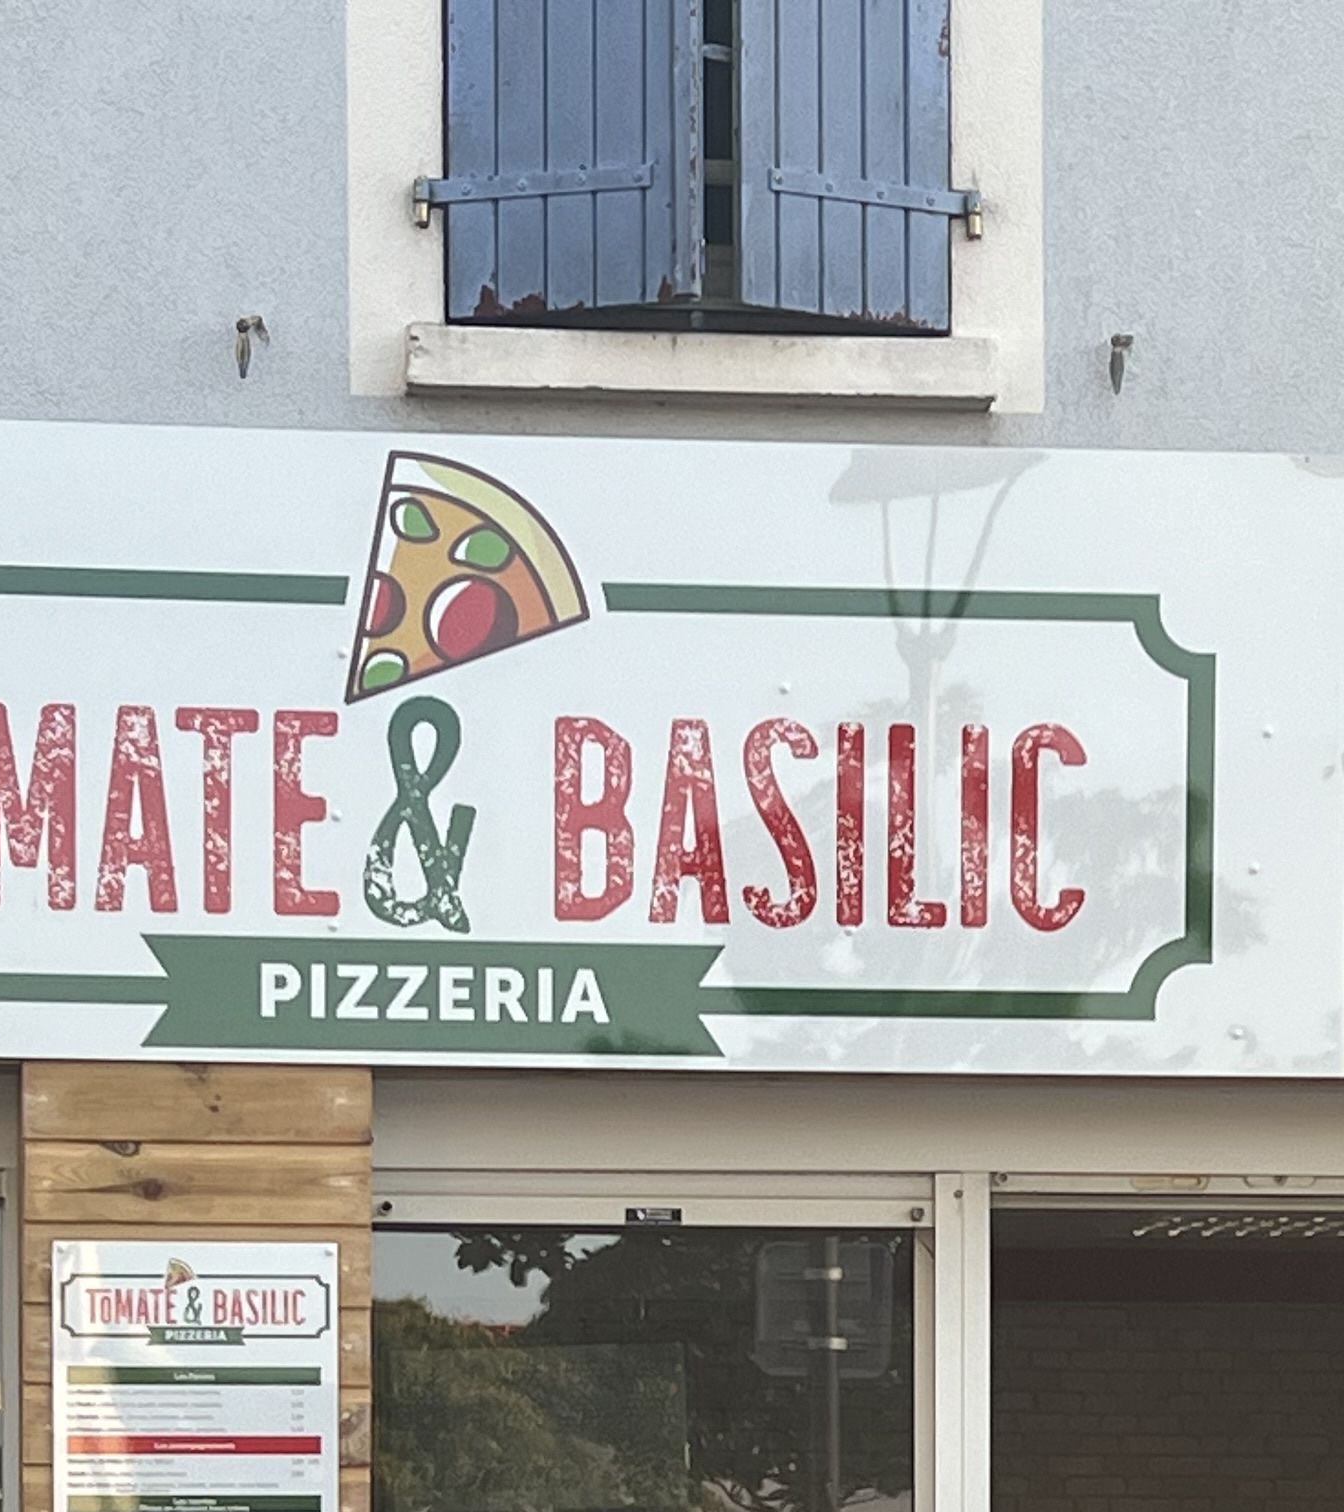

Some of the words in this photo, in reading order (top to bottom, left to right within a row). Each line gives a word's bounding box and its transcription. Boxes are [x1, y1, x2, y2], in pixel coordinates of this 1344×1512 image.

[362, 694, 476, 934] &
[553, 716, 1086, 931] BASILIC
[258, 960, 610, 1025] PIZZERIA
[86, 1288, 177, 1324] TOMATE
[183, 1286, 203, 1325] &
[213, 1288, 306, 1326] BASILIC
[164, 1329, 227, 1342] PIZZERIA
